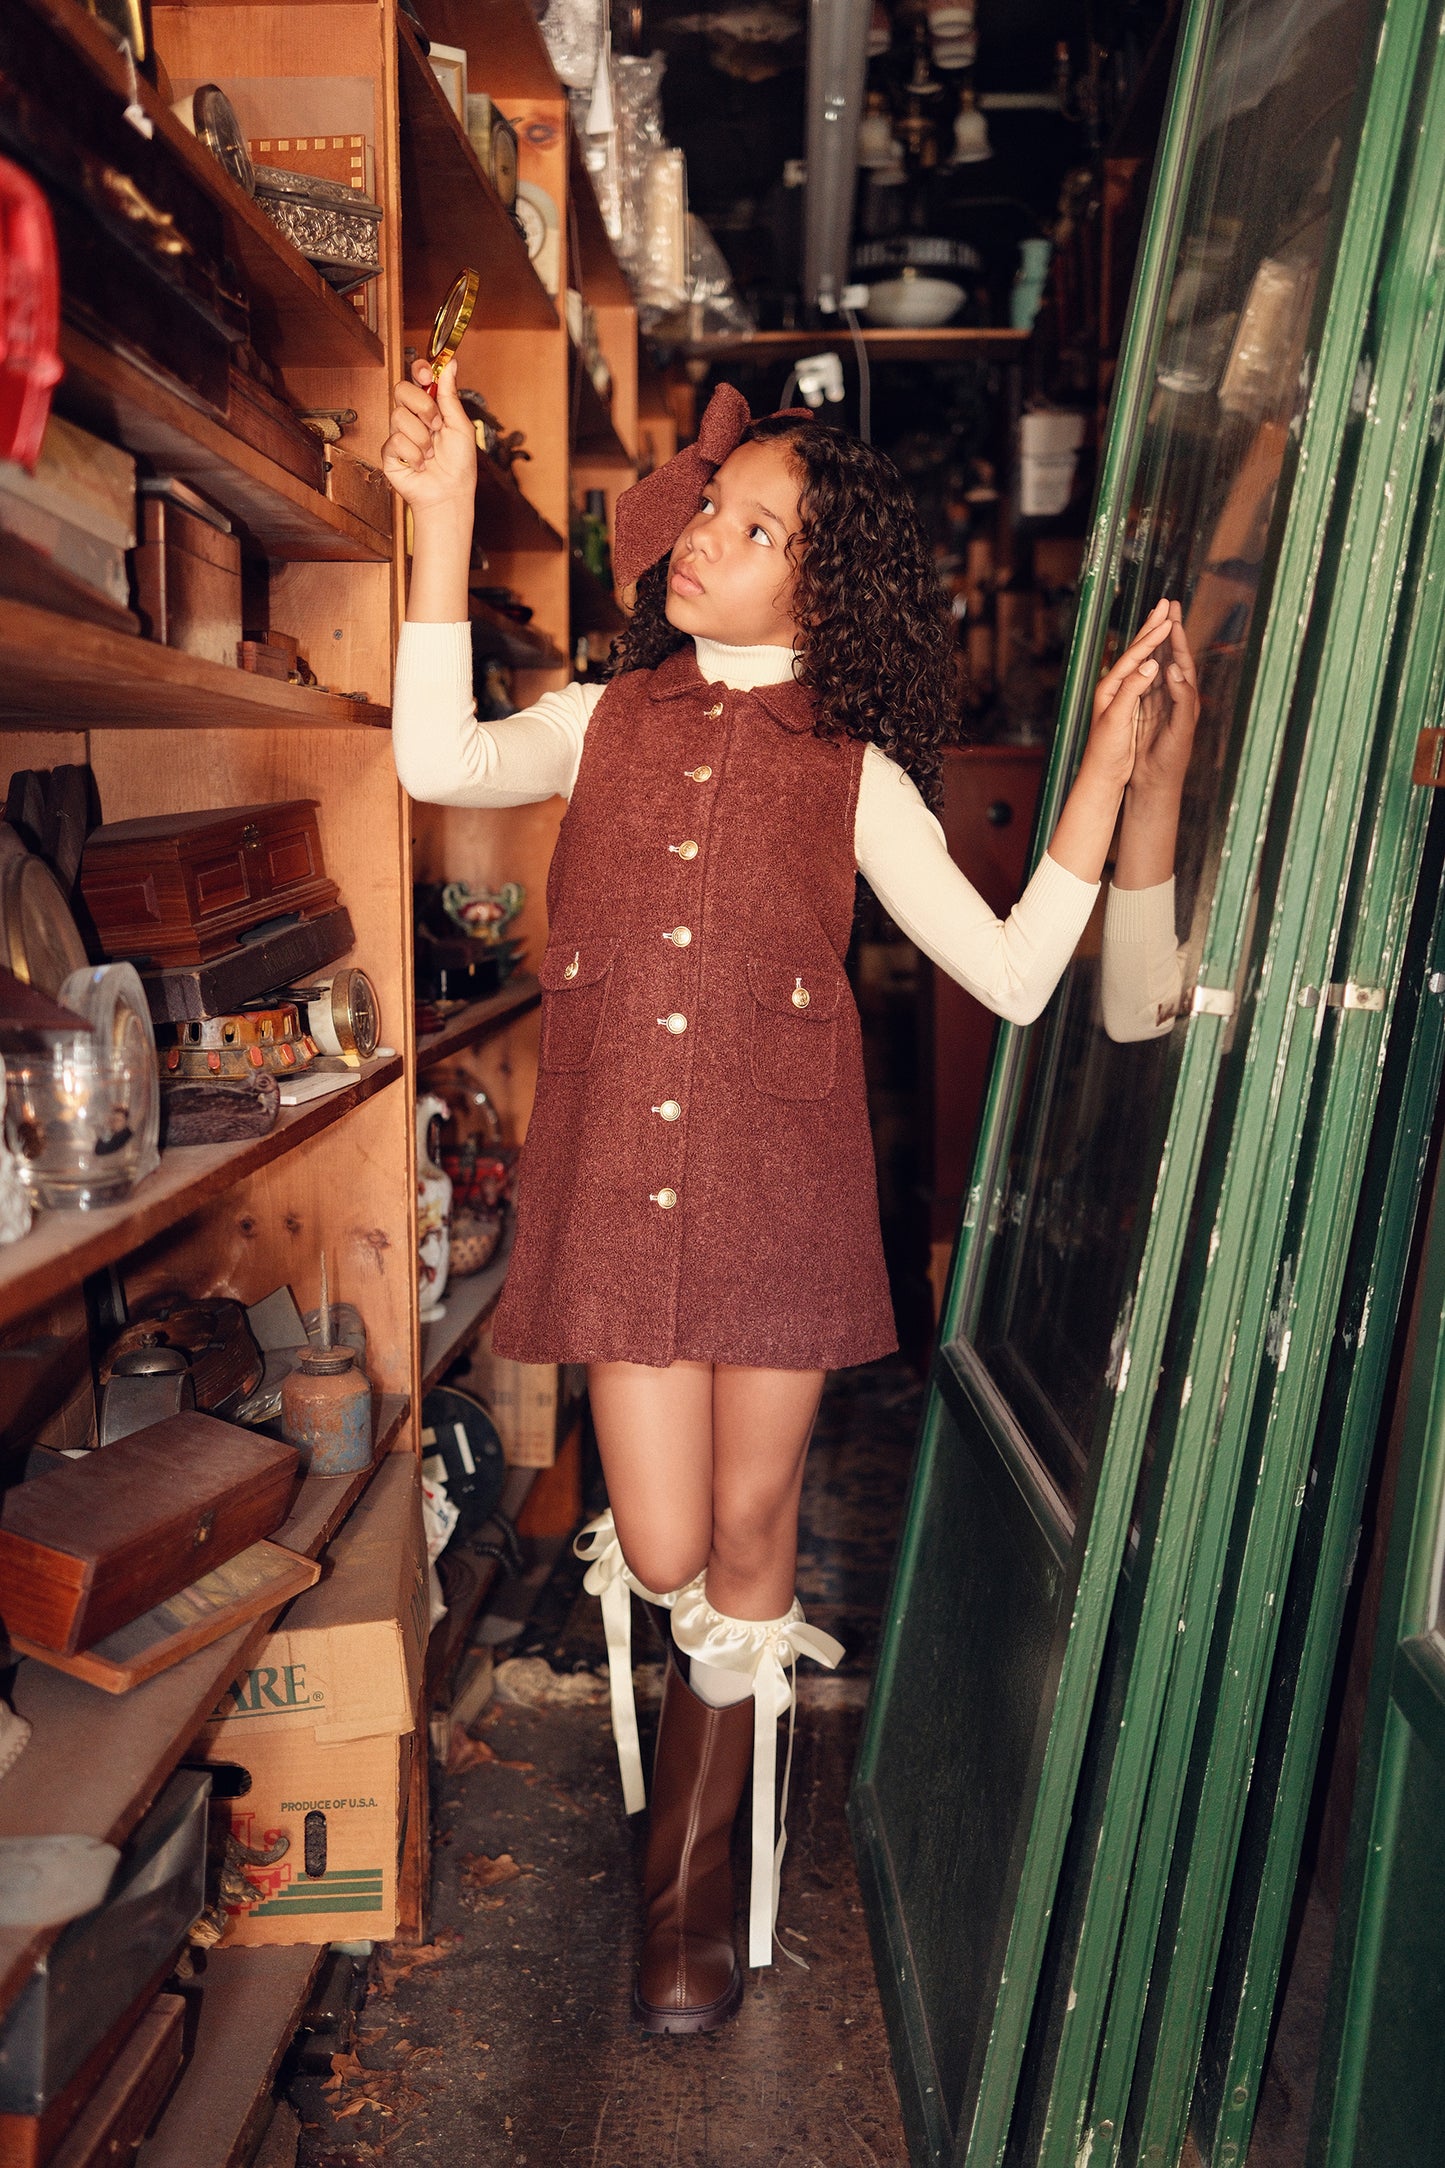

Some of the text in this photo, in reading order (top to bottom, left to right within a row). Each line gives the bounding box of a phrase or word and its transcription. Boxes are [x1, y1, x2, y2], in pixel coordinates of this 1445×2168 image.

[281, 1798, 378, 1812] PRODUCE OF U.S.A.
